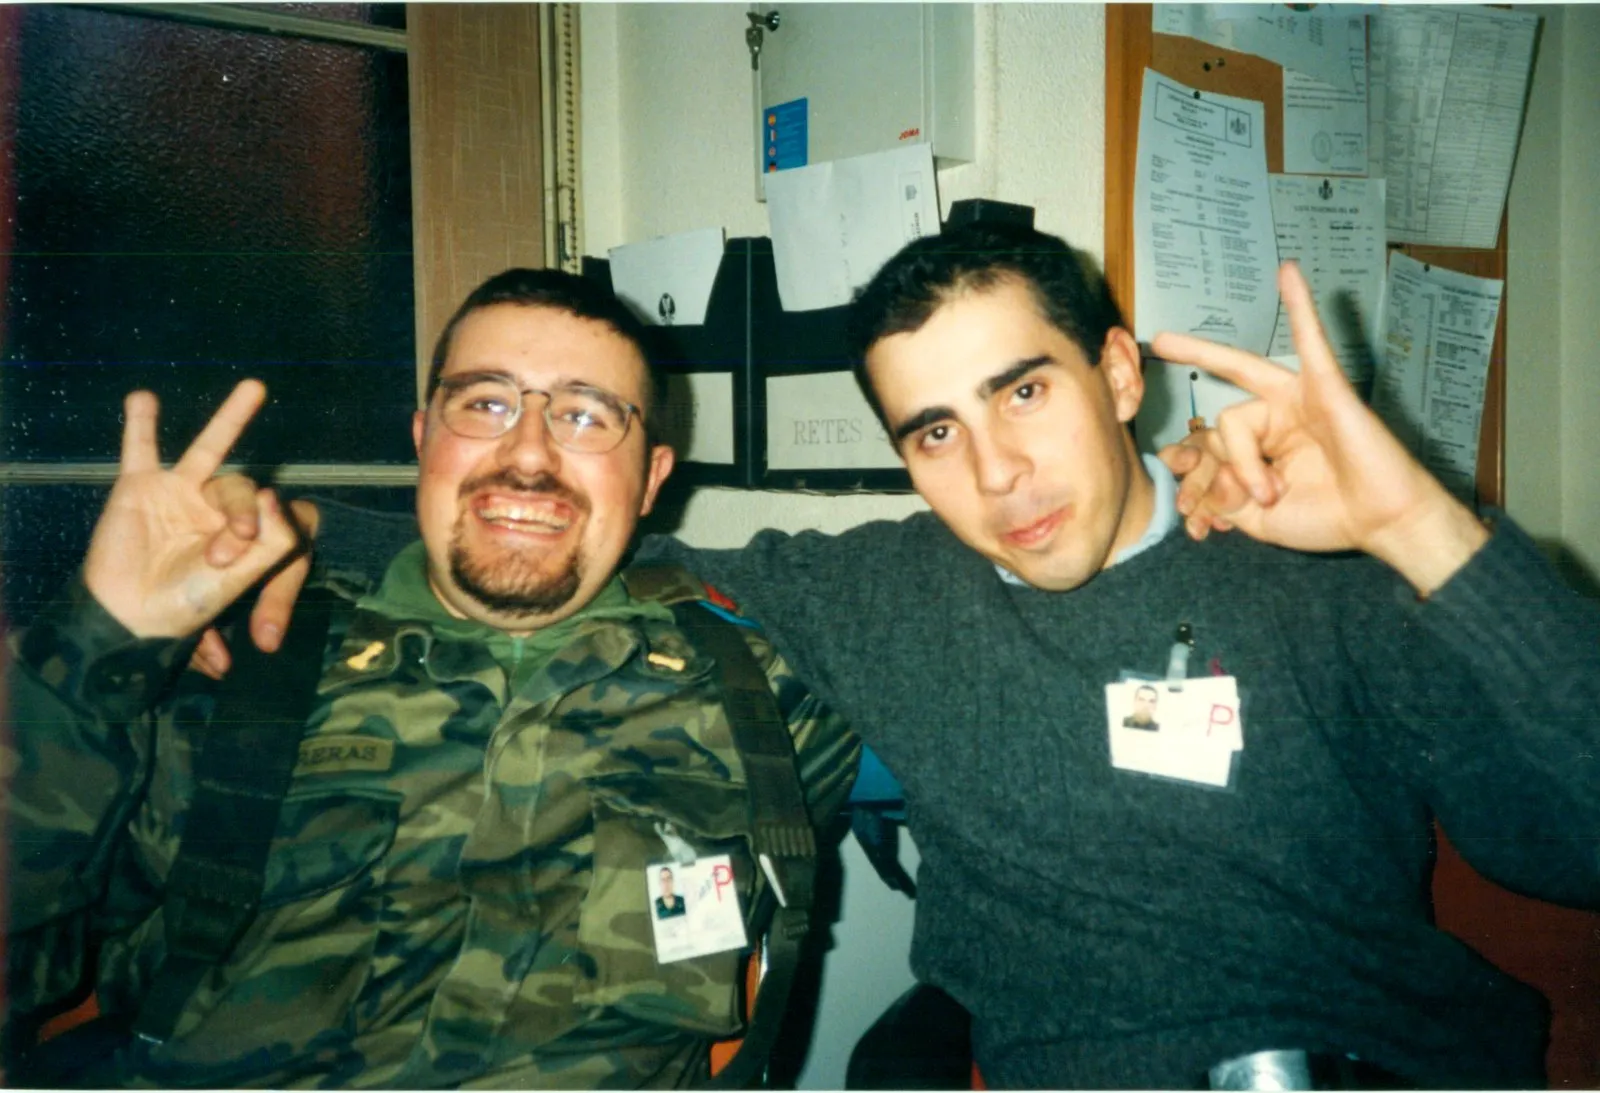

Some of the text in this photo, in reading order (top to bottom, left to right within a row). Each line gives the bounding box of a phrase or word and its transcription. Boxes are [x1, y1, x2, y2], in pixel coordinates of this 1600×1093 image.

[793, 419, 862, 445] RETES
[1206, 704, 1234, 737] P
[713, 865, 734, 903] P
